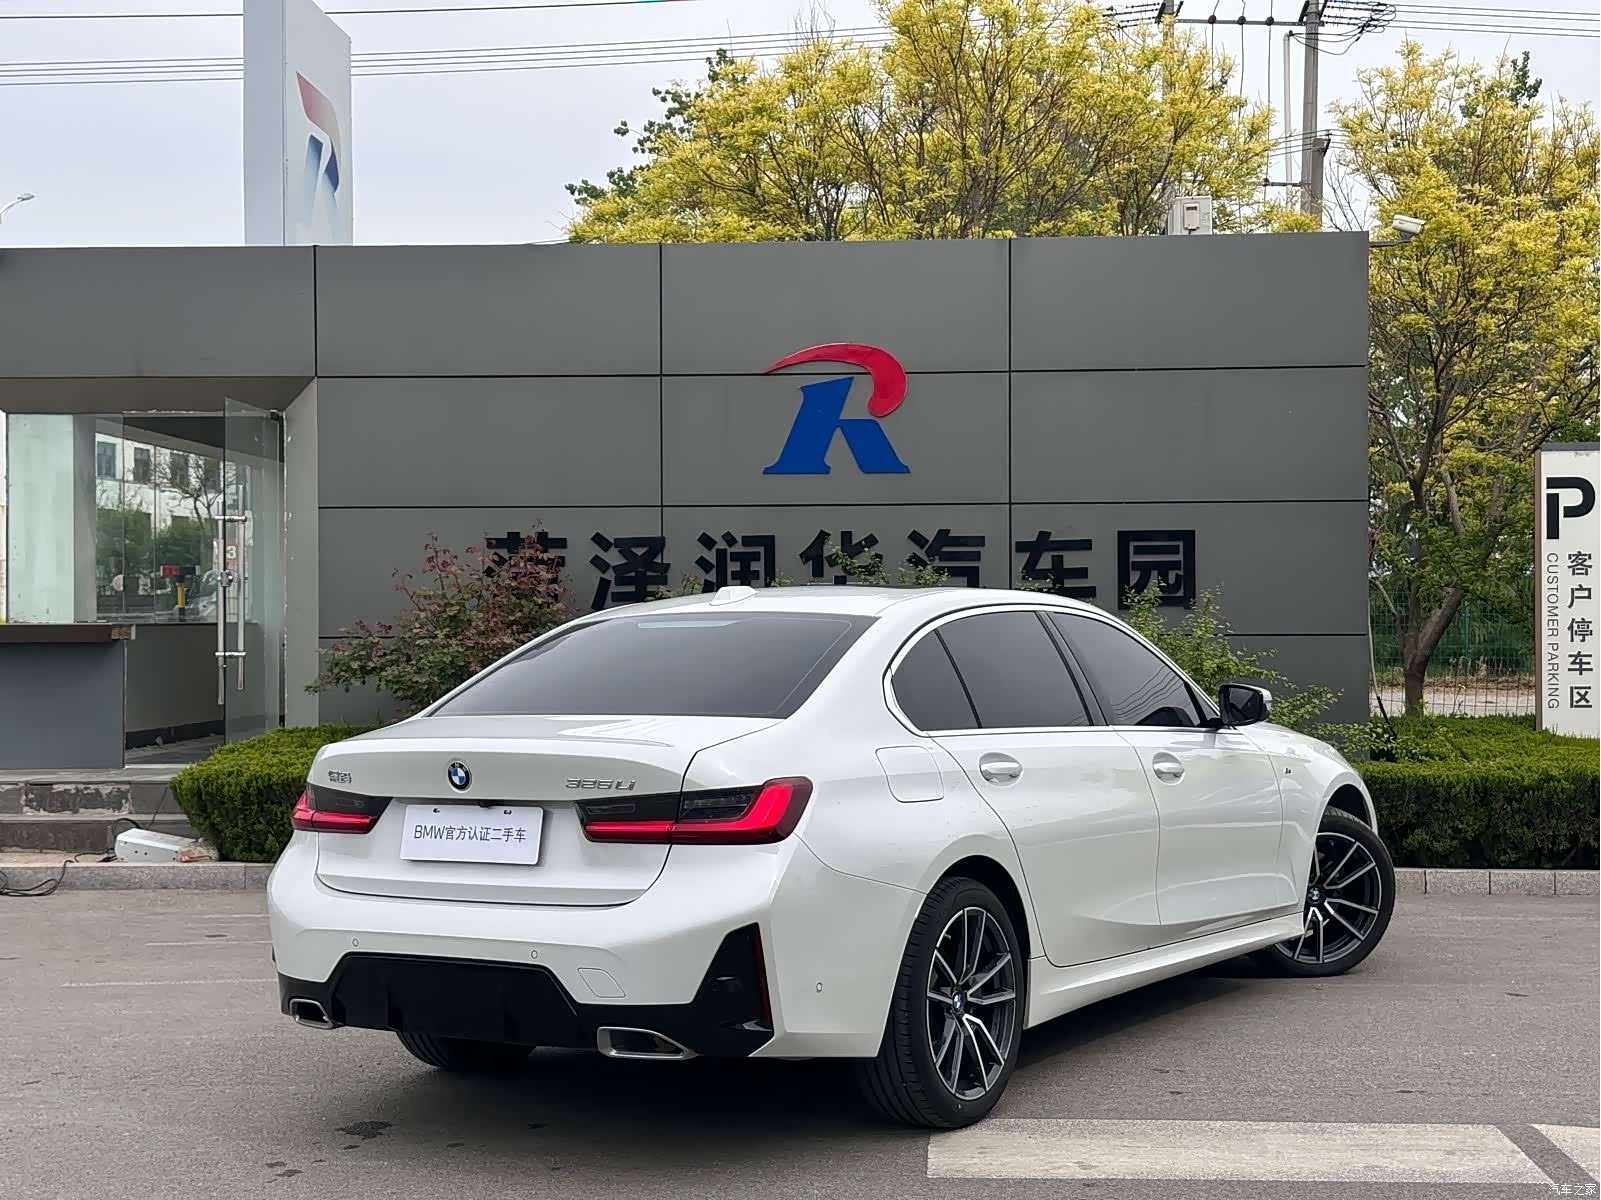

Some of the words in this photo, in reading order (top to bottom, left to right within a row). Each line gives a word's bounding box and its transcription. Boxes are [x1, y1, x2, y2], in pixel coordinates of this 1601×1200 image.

[1546, 476, 1596, 540] P
[1546, 552, 1560, 638] CUSTOMER
[1567, 550, 1594, 709] 客户停车区
[1547, 641, 1560, 710] PARKING
[414, 824, 526, 842] BMW官方认证二手车
